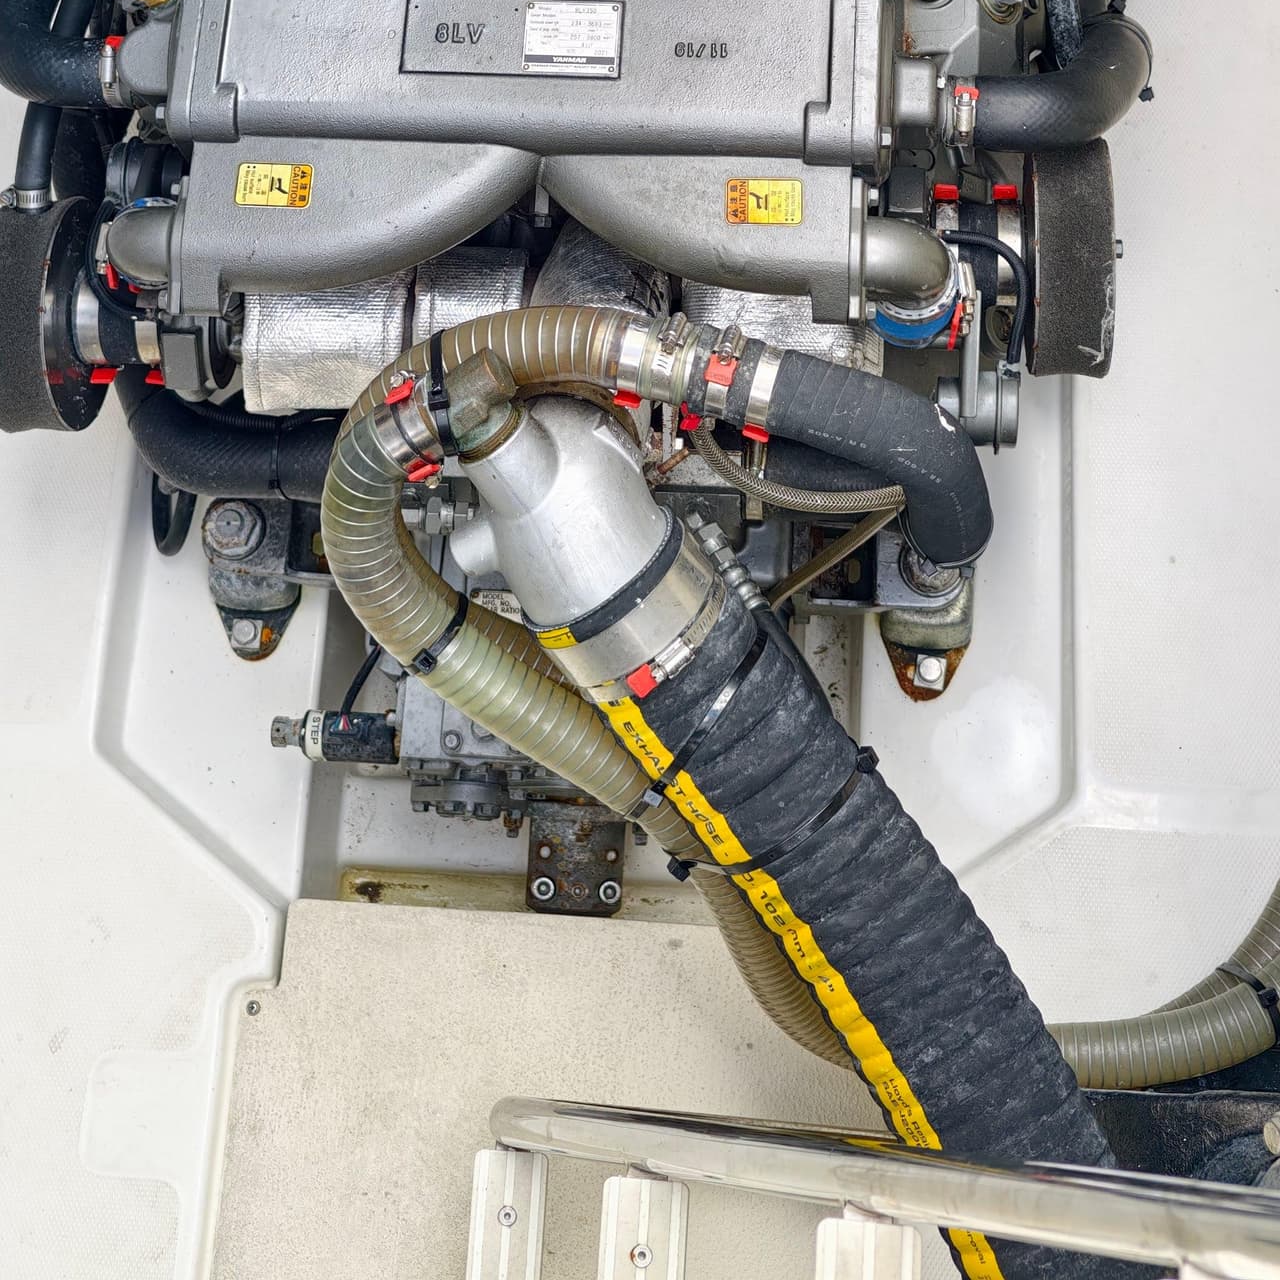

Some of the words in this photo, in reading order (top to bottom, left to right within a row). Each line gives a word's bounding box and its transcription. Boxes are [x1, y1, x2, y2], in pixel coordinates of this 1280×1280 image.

[434, 21, 486, 45] 8LV
[289, 166, 301, 206] CAUTION
[482, 592, 504, 600] MODEL
[310, 716, 321, 745] STEP
[685, 799, 726, 847] HOSE
[760, 890, 787, 929] 102
[888, 1077, 913, 1118] Lloyd's
